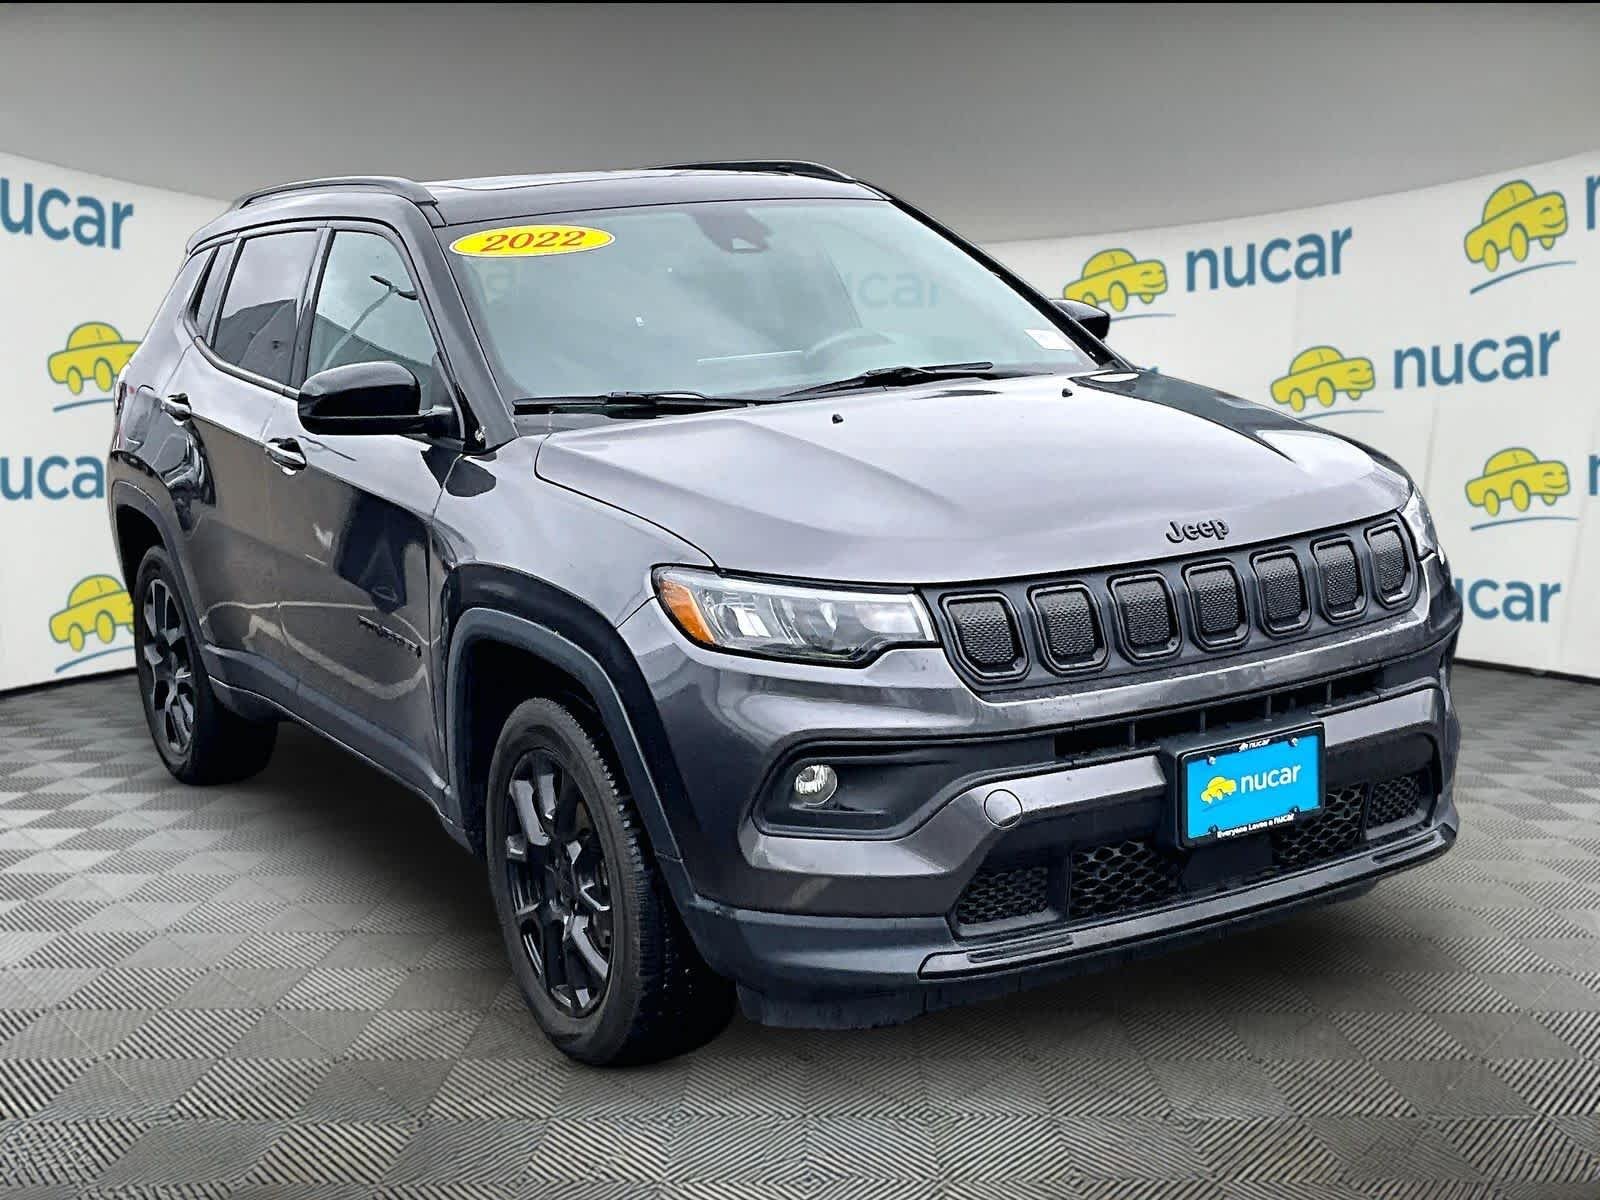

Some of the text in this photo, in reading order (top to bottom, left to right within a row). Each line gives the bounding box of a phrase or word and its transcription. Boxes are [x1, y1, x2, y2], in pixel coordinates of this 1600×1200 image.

[0, 177, 134, 250] ucar
[480, 230, 587, 253] 2022
[1186, 226, 1353, 293] nucar
[1394, 330, 1561, 390] nucar
[0, 455, 105, 501] uca
[1165, 519, 1230, 544] Jeep
[1454, 578, 1562, 625] car
[1240, 764, 1302, 794] nucar
